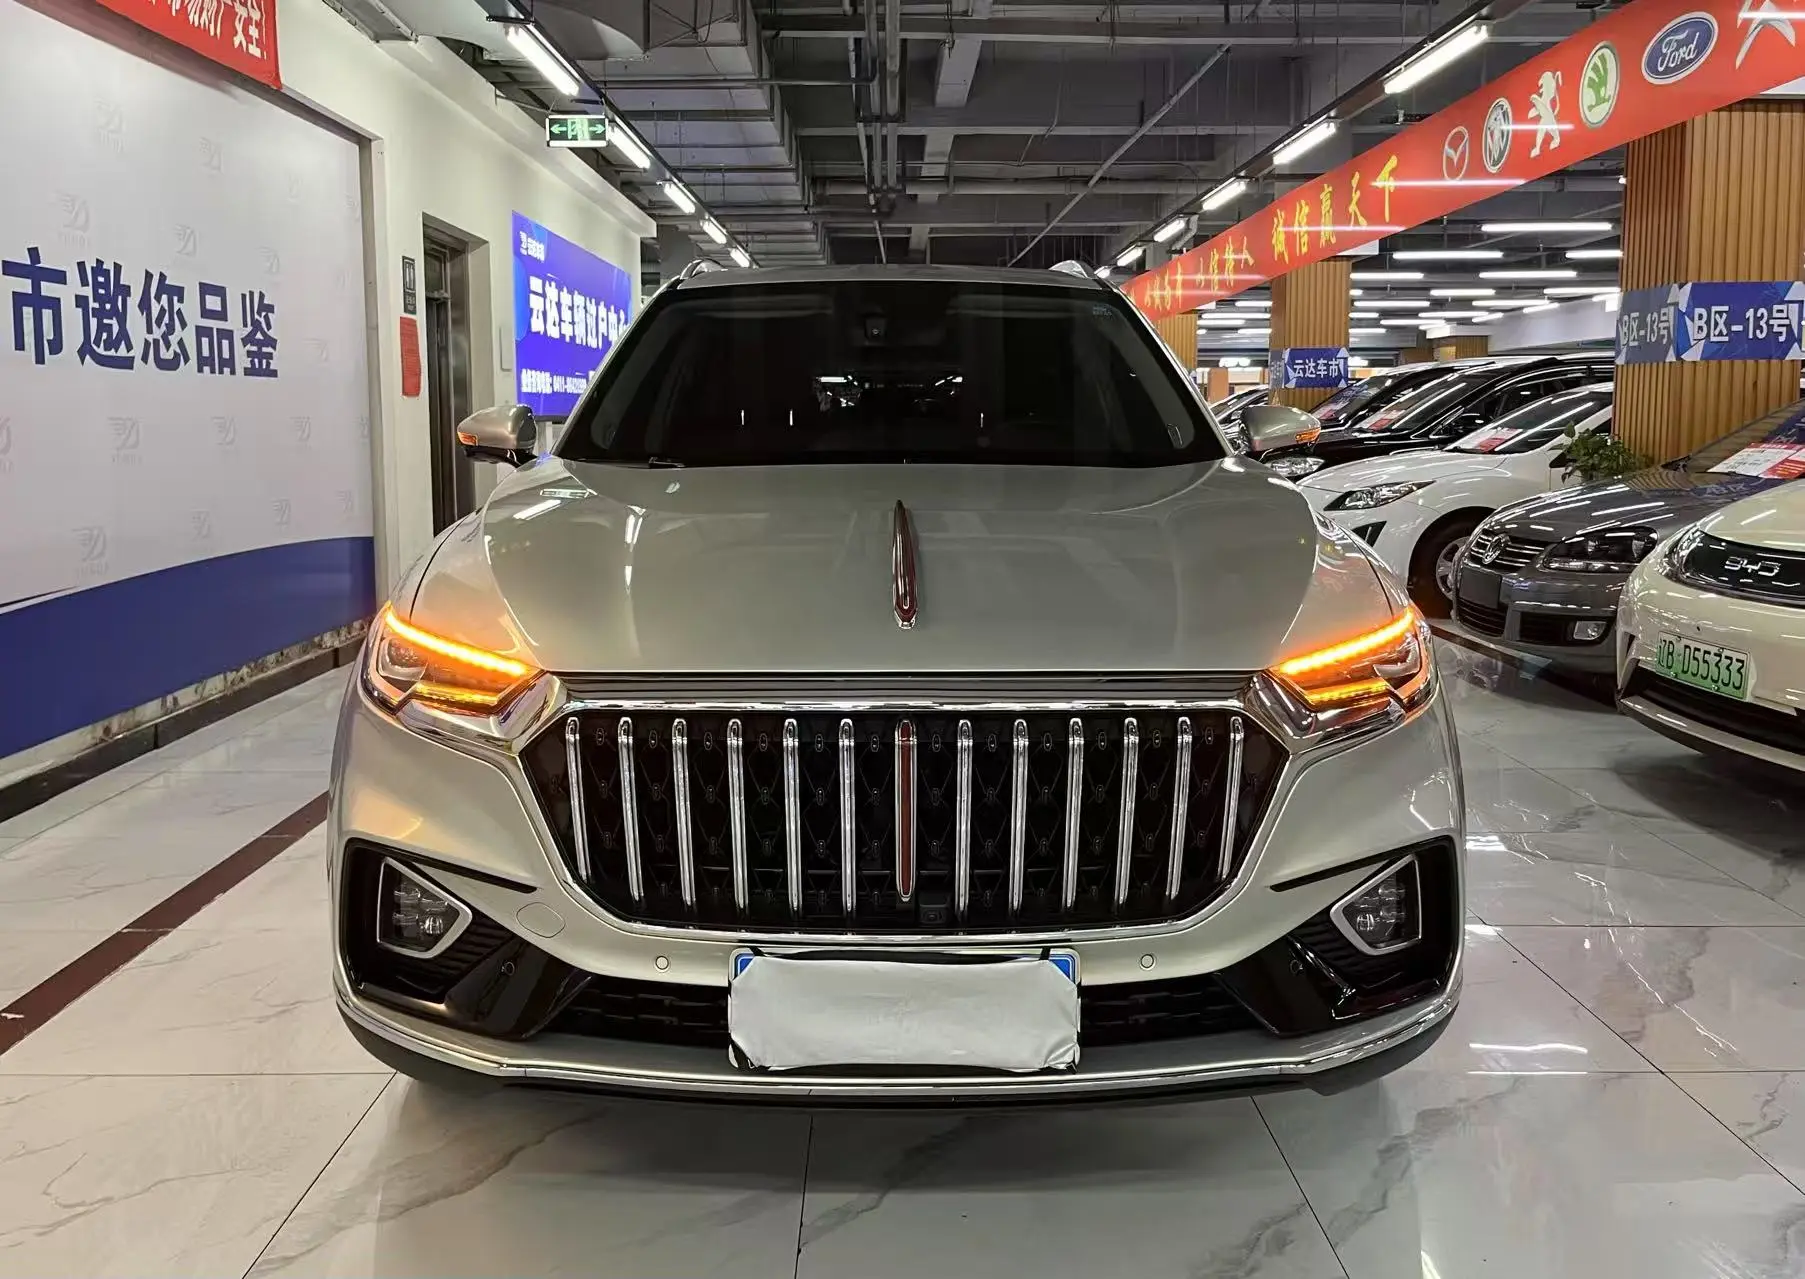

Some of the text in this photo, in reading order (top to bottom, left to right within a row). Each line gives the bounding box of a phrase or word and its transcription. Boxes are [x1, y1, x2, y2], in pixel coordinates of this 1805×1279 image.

[1656, 31, 1699, 72] Ford
[1271, 154, 1399, 265] 诚信赢天下
[1, 246, 279, 378] 市邀您品鉴
[1621, 306, 1671, 347] B区-13号
[1693, 304, 1791, 343] B区-13号
[1293, 357, 1340, 379] 云达车市
